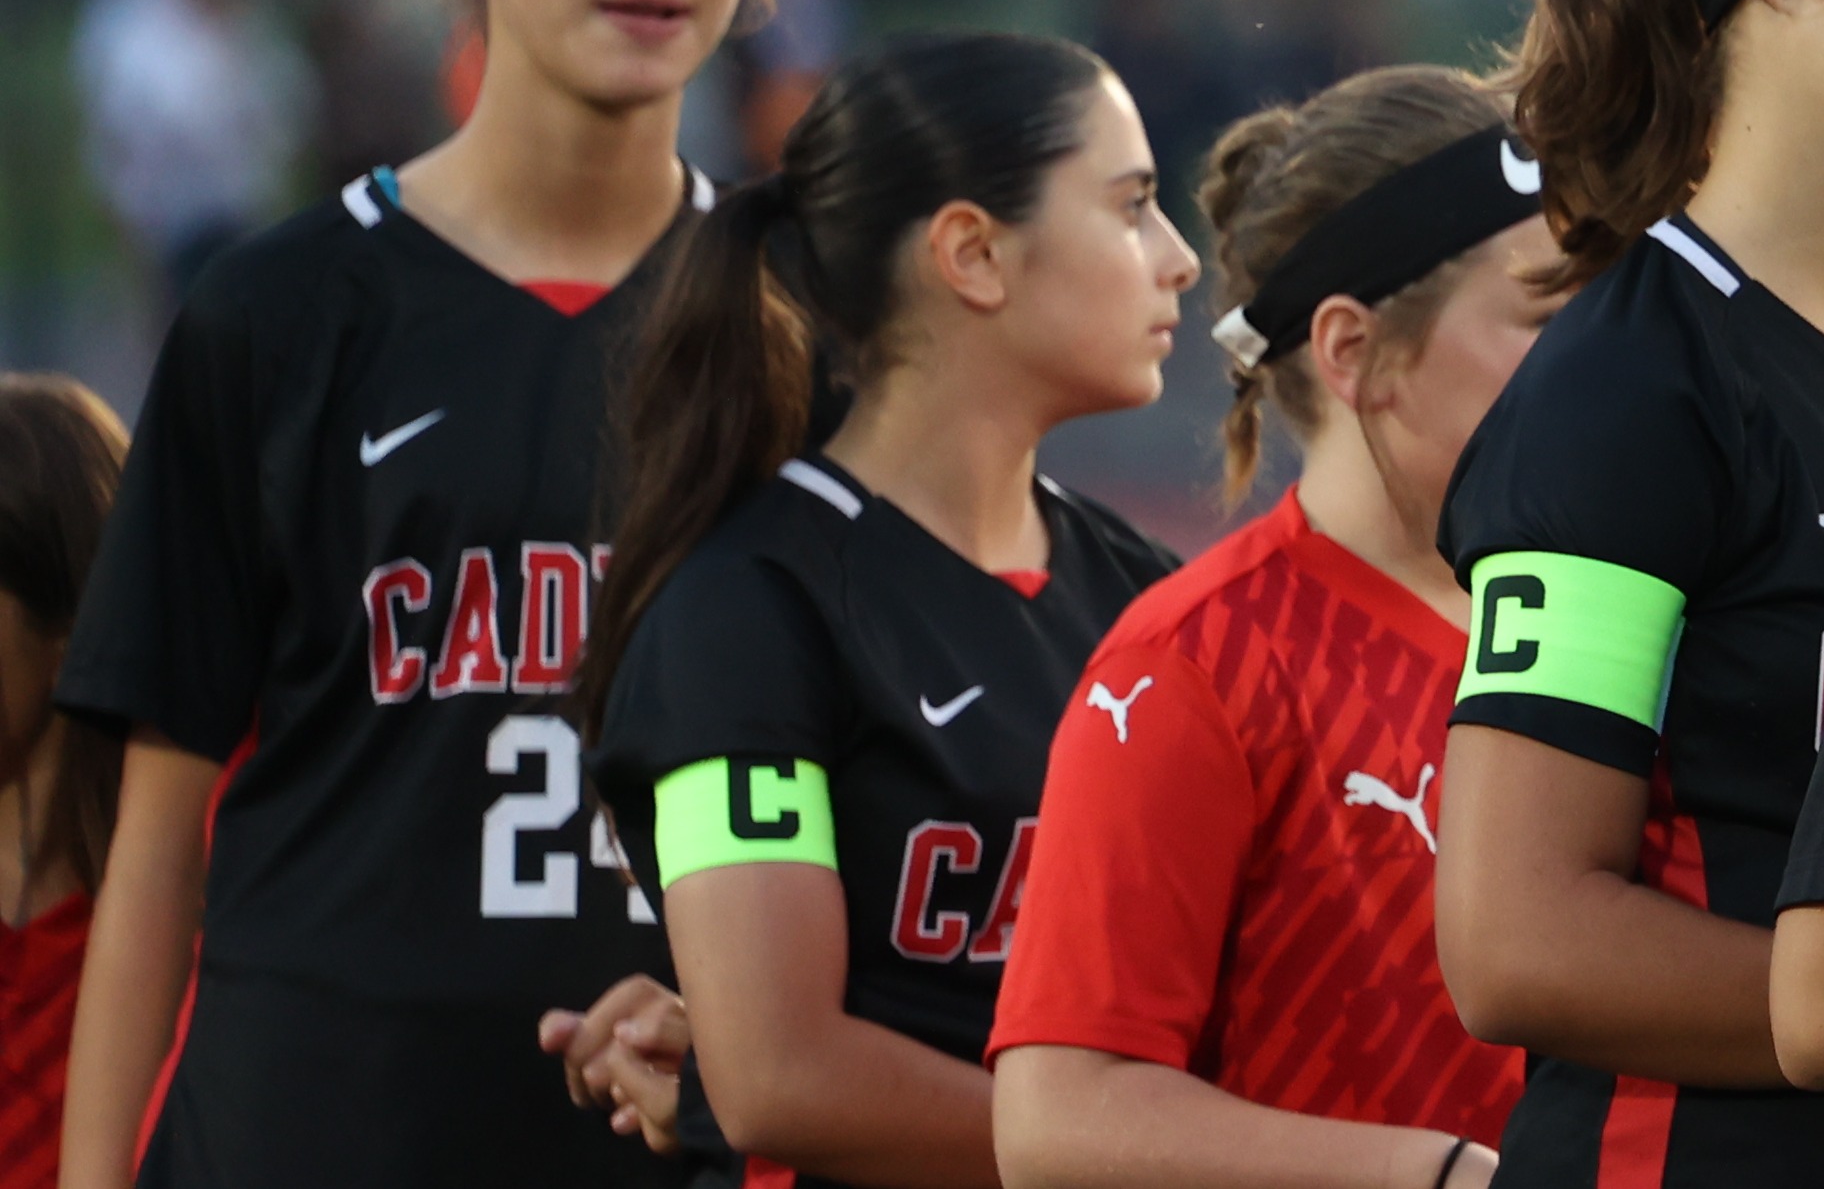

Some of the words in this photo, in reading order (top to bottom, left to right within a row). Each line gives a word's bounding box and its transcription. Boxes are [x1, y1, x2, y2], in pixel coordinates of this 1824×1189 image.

[363, 541, 612, 704] CAD
[1476, 575, 1545, 674] C
[728, 756, 800, 839] C
